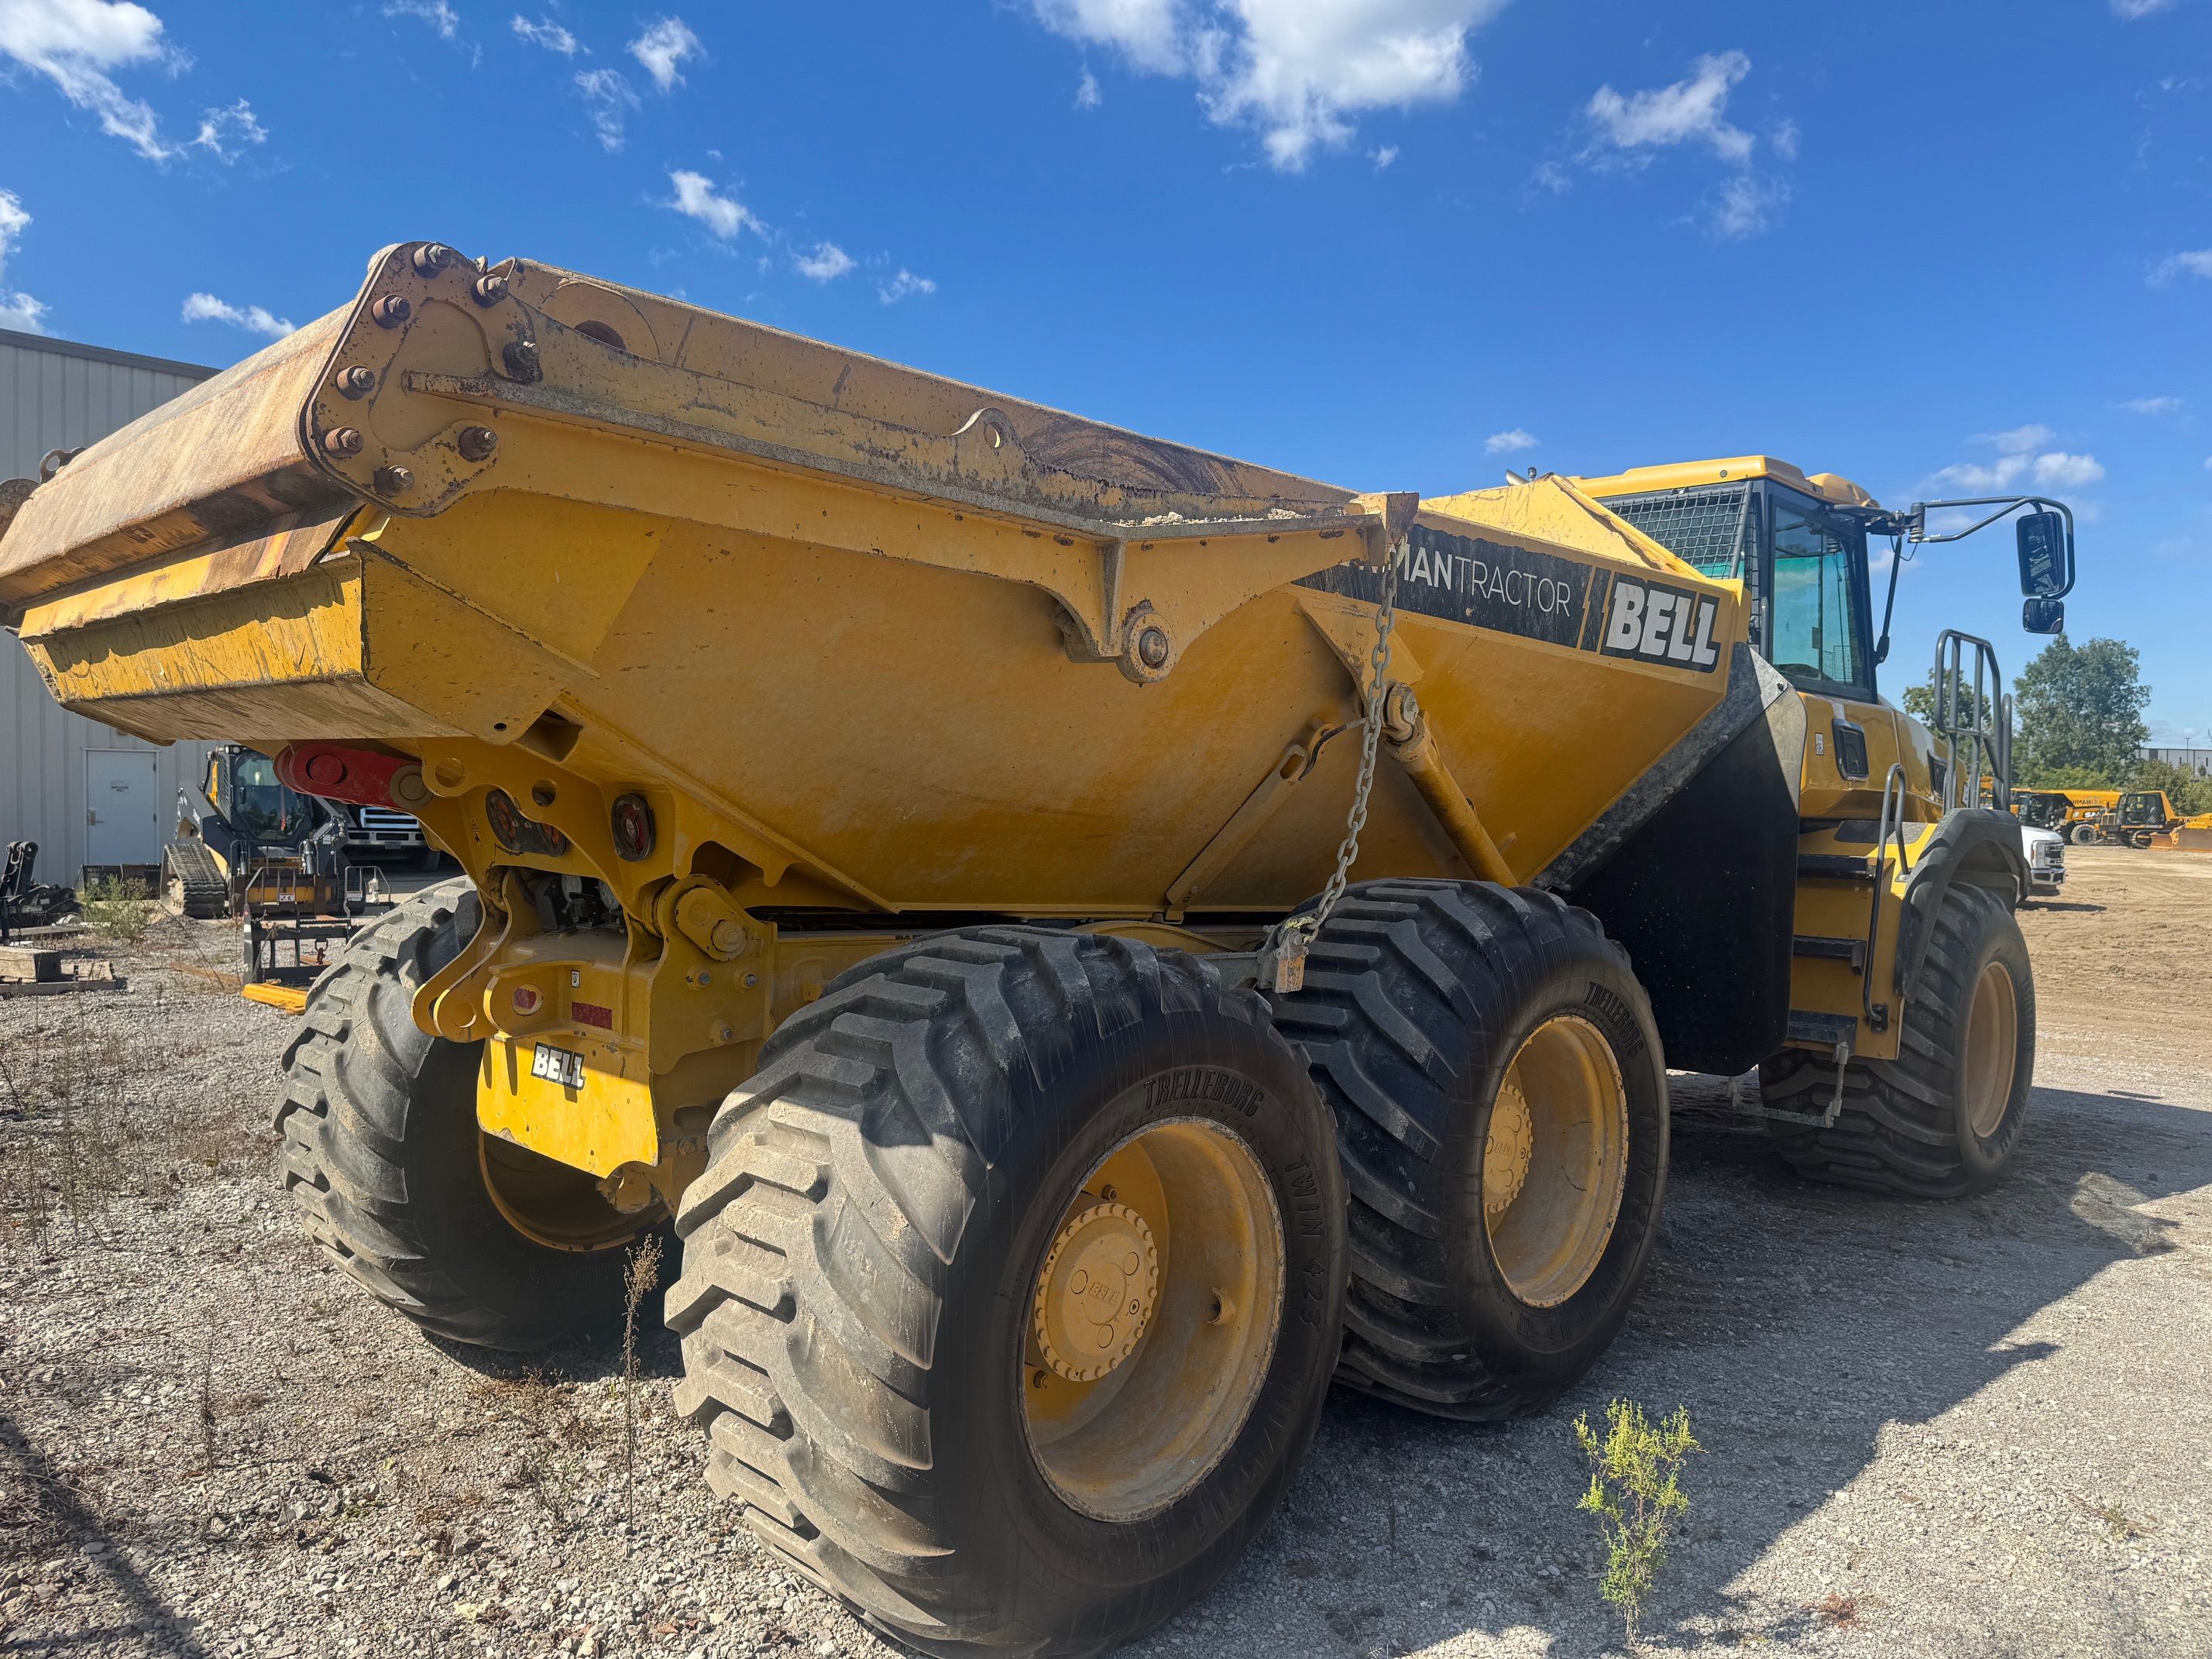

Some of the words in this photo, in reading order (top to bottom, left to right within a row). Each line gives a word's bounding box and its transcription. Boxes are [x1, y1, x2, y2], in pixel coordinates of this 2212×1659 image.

[1340, 544, 1571, 617] MANTRACTOR
[1606, 582, 1716, 666] BELL
[1585, 981, 1644, 1058] TRELLEBORG
[531, 1046, 584, 1087] BELL
[1144, 1068, 1264, 1117] TRELLEBORG
[1284, 1154, 1324, 1237] TWIN
[1087, 1281, 1121, 1307] BELL
